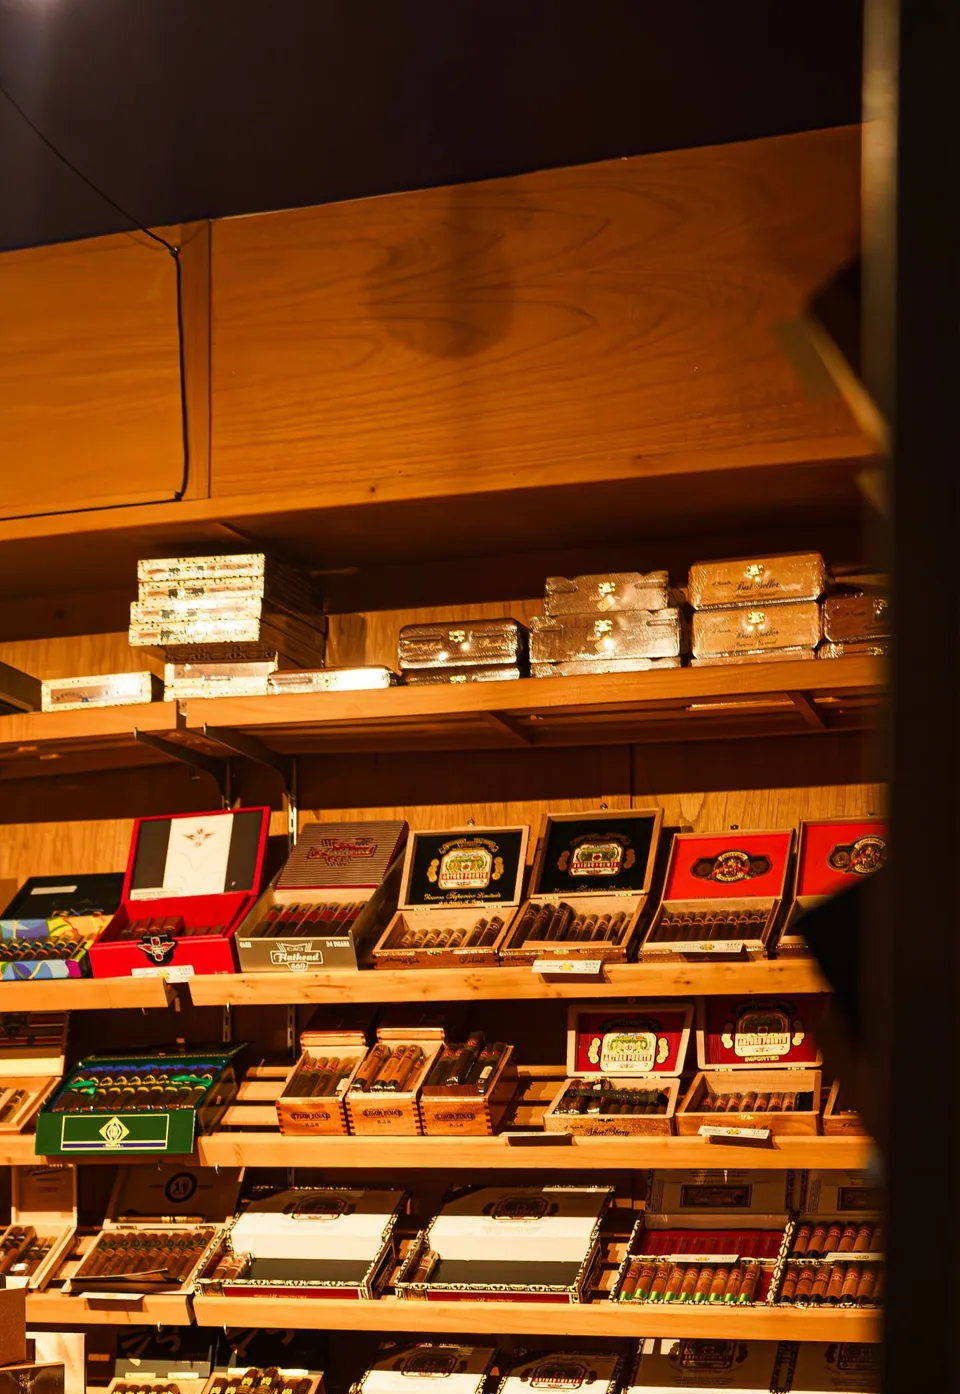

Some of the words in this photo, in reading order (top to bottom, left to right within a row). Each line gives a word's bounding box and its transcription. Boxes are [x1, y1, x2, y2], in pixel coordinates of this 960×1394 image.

[273, 952, 320, 963] Flathead
[585, 1127, 607, 1137] Short
[608, 1127, 630, 1138] Story
